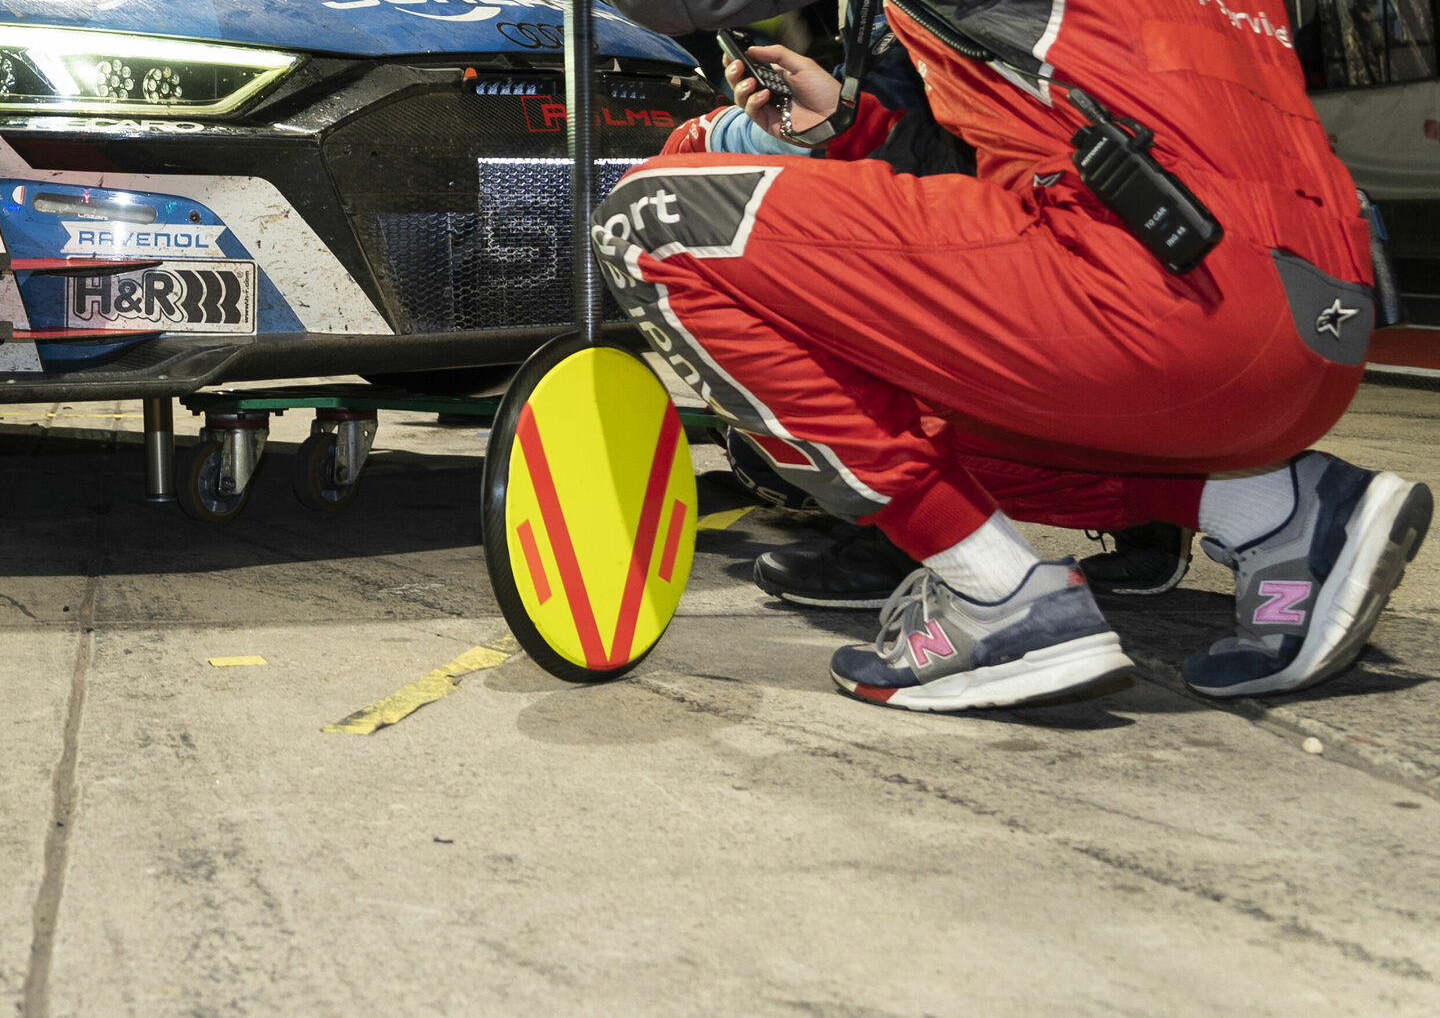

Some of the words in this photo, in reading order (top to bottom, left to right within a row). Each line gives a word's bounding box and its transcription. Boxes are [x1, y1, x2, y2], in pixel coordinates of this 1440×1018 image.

[602, 108, 676, 128] LMS
[78, 230, 209, 249] RAVENOL
[75, 269, 177, 318] H&R
